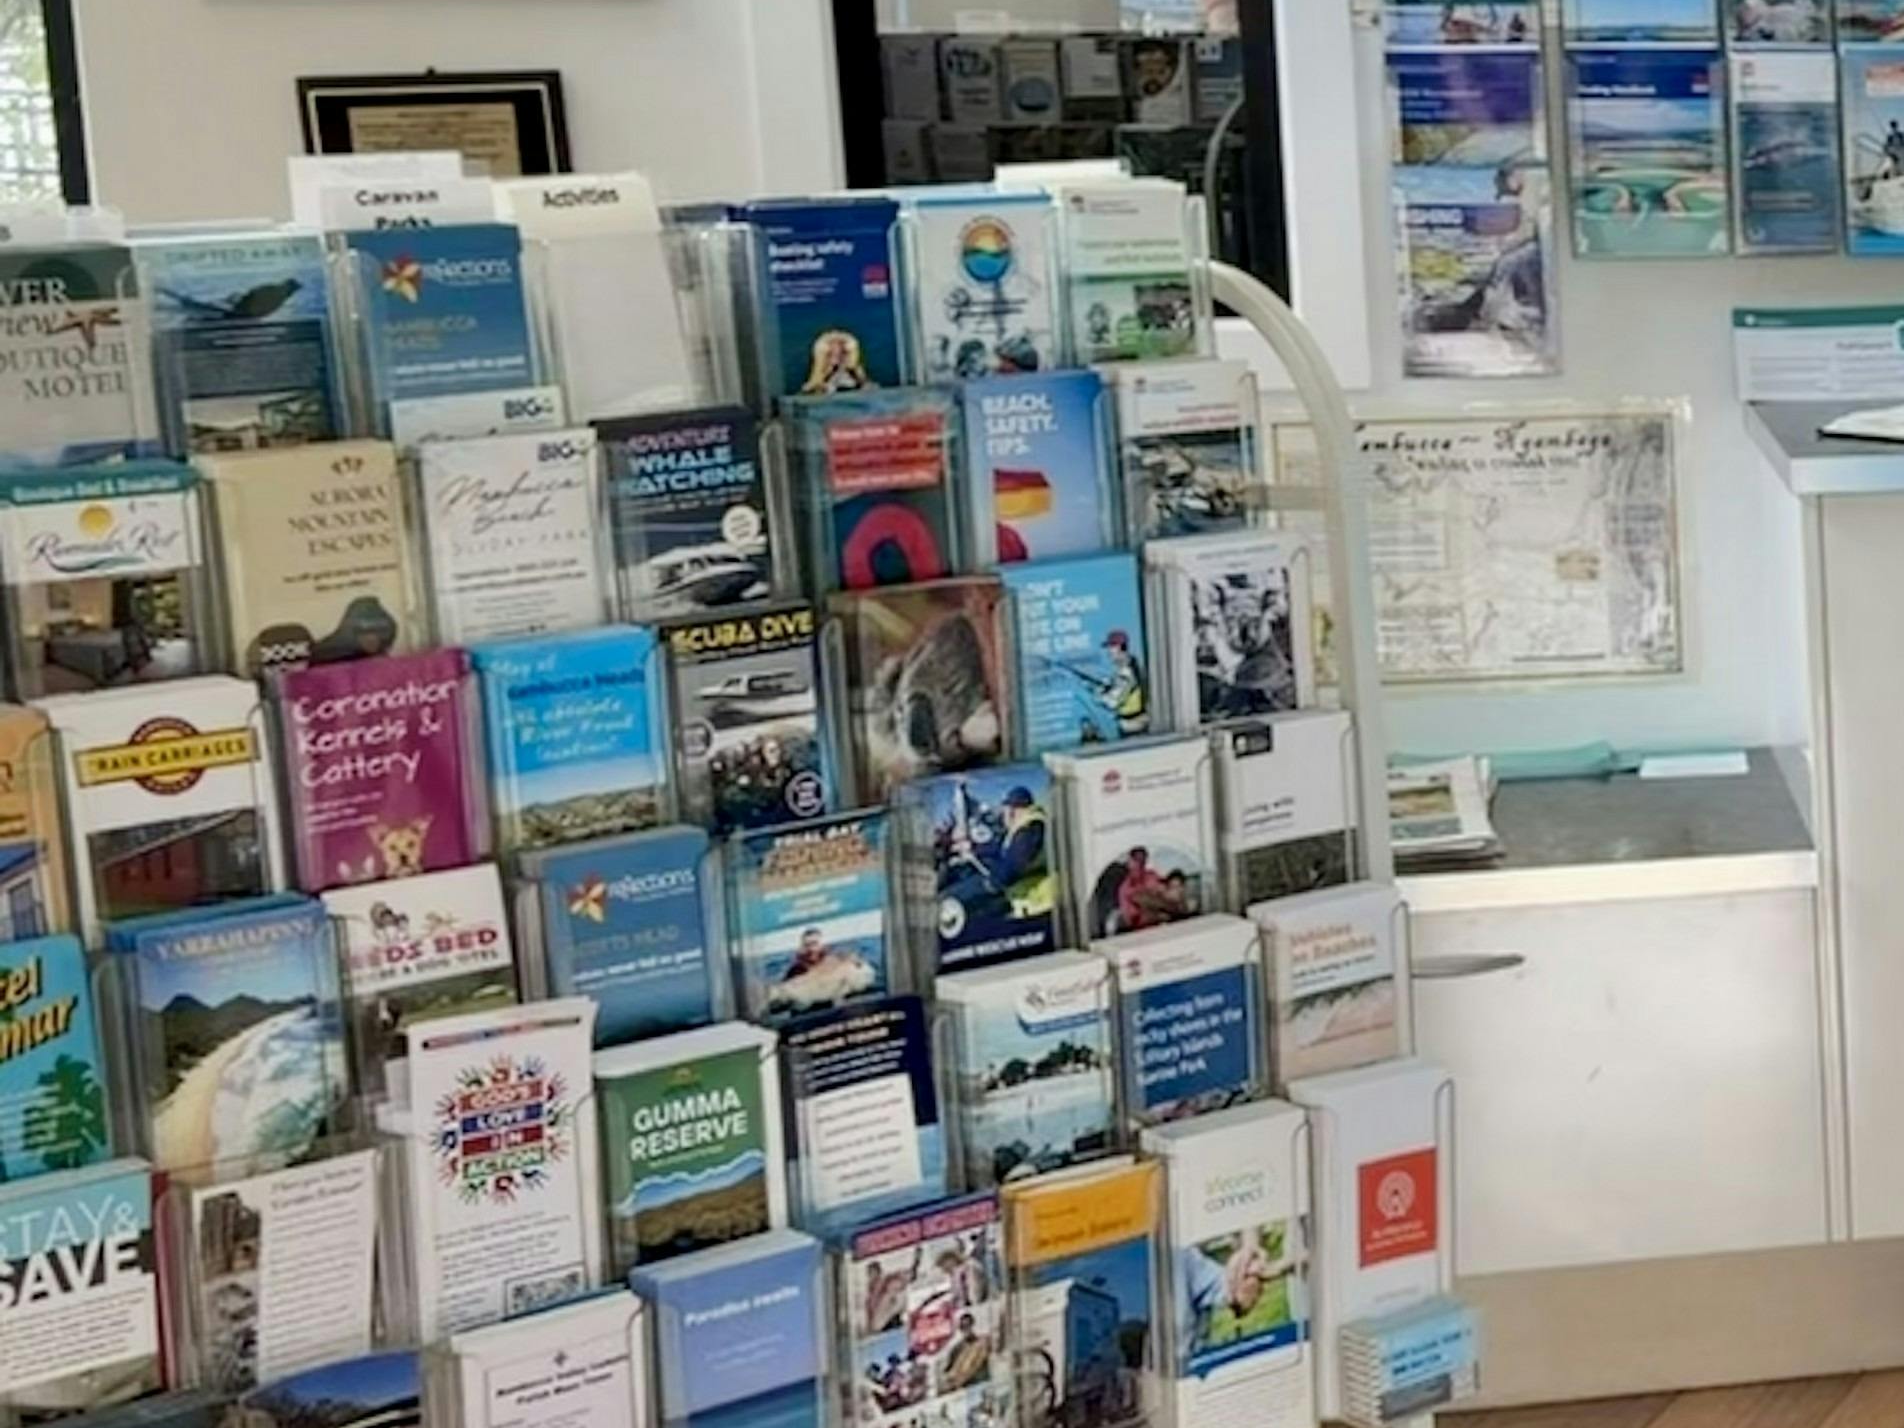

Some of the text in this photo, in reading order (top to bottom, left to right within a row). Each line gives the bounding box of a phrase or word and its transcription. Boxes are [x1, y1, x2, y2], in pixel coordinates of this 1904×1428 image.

[356, 188, 439, 207] Caravan
[542, 186, 620, 208] Activities
[816, 240, 854, 258] safety
[627, 446, 733, 474] WHALE
[671, 611, 815, 653] SCUBA DIVE
[292, 678, 459, 725] Coronation
[299, 706, 444, 758] Kennels &
[147, 737, 248, 766] CARRIAGES
[301, 748, 421, 790] Cattery
[475, 1109, 528, 1133] LOVE
[632, 1086, 743, 1134] GUMMA
[629, 1110, 750, 1162] RESERVE
